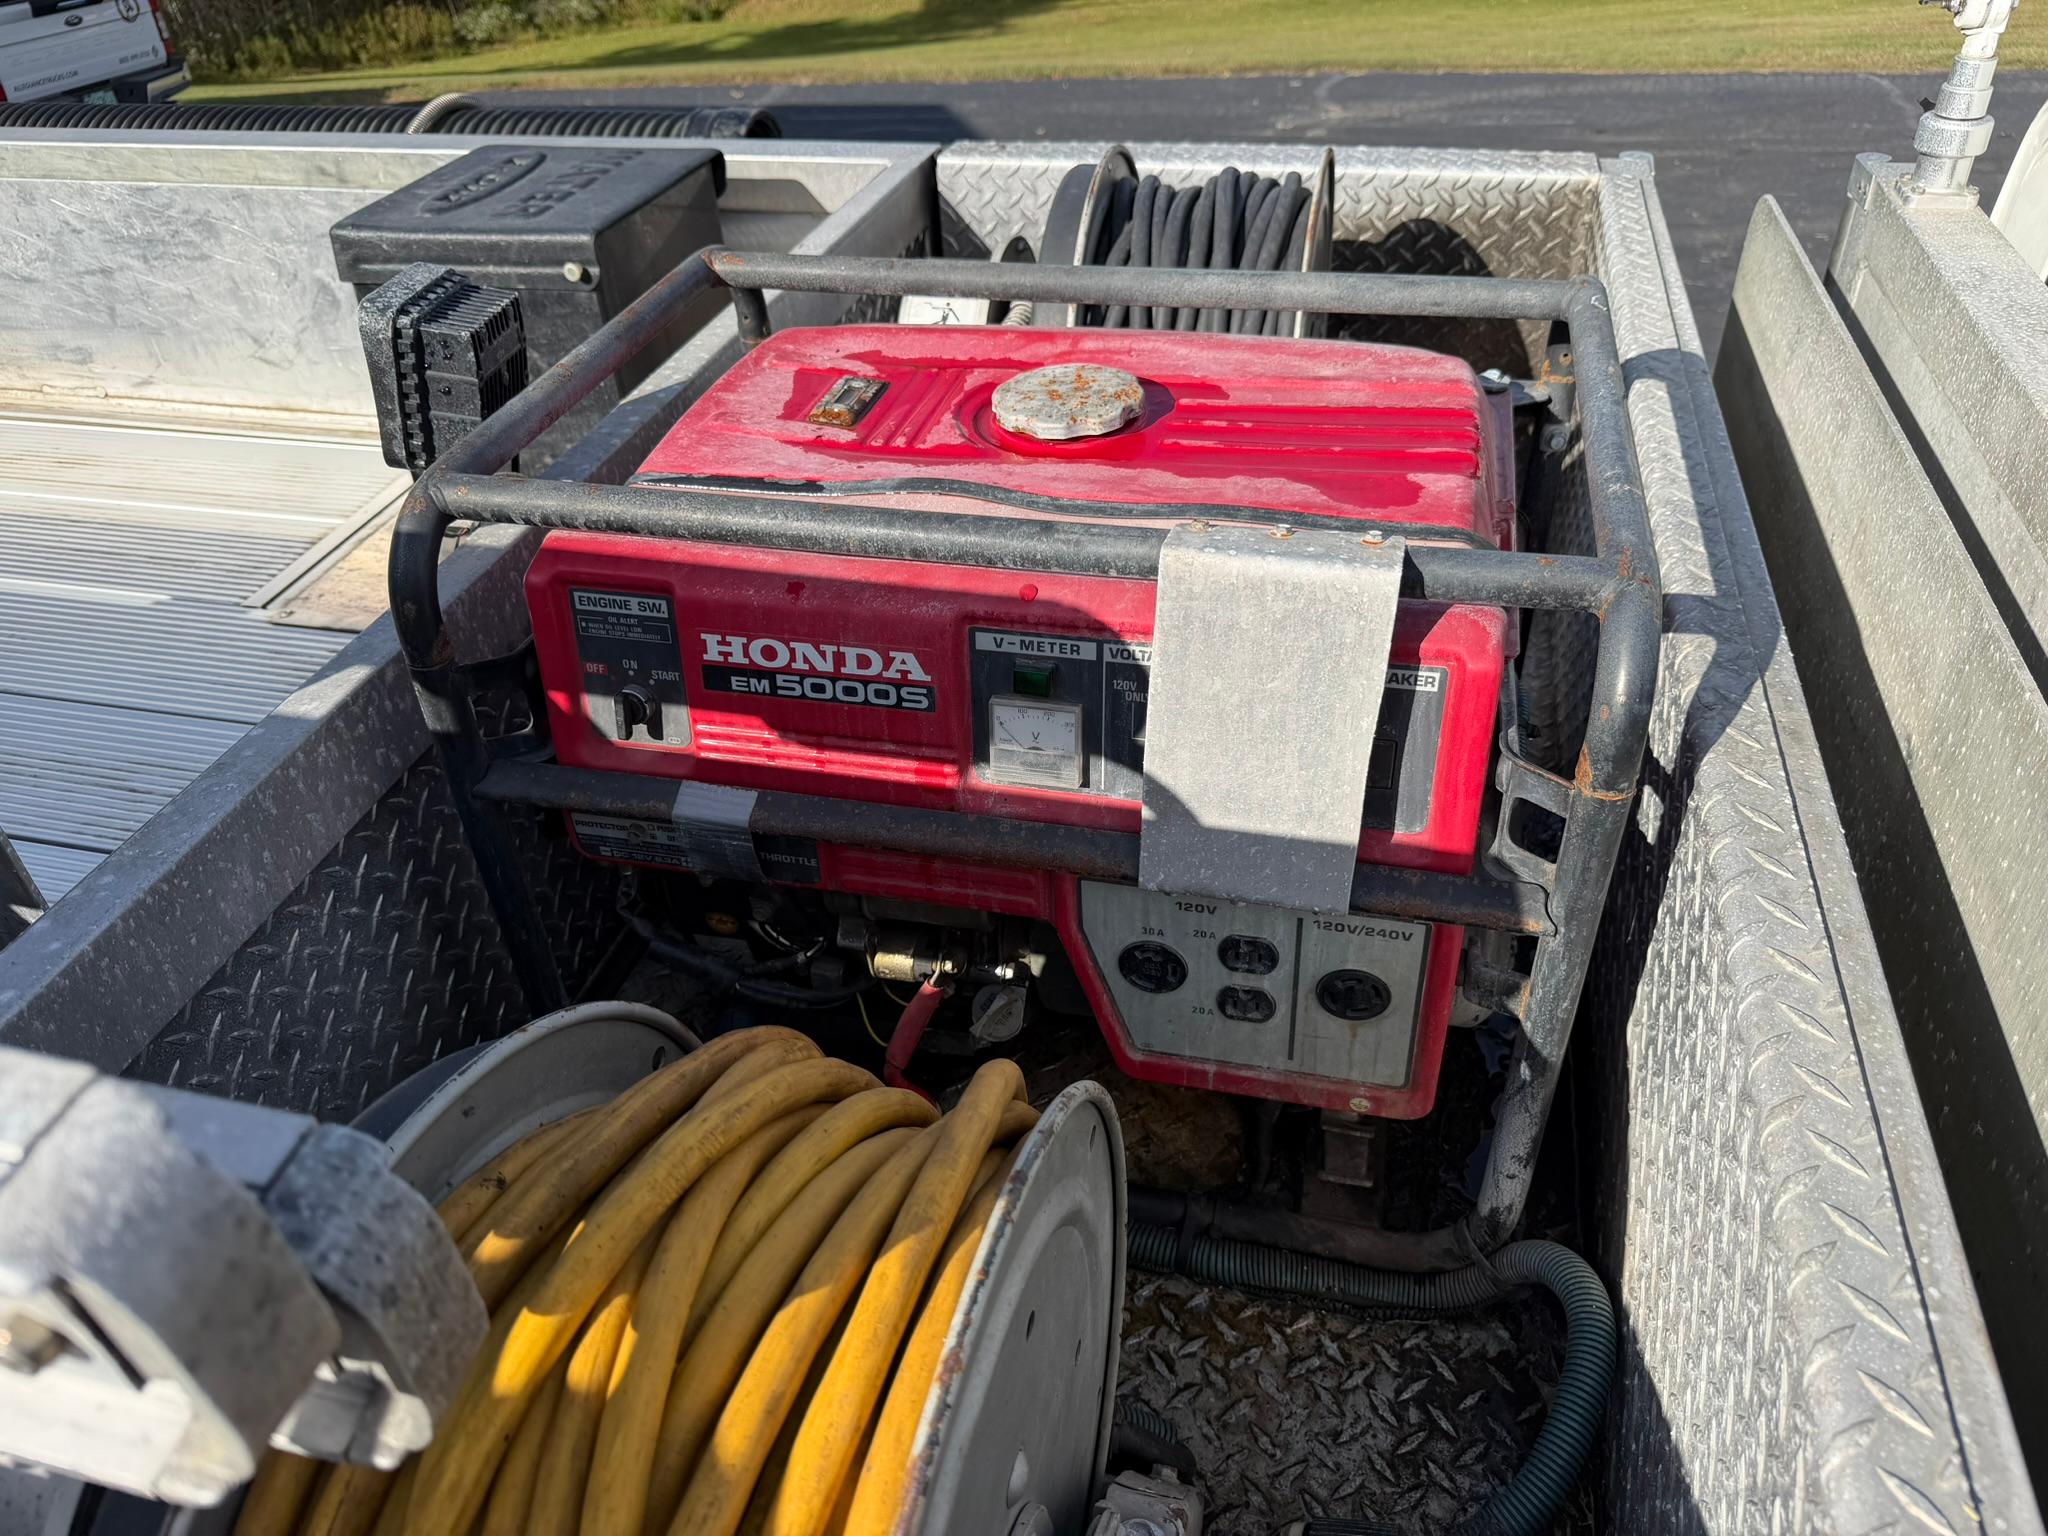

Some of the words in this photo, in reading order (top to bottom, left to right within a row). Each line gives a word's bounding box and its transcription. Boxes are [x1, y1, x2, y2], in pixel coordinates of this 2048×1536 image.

[578, 595, 632, 611] ENGINE
[638, 601, 665, 614] SW.
[607, 616, 618, 624] OIL
[701, 633, 931, 681] HONDA
[586, 662, 605, 673] OFF
[622, 659, 638, 669] ON
[651, 670, 681, 681] START
[1386, 671, 1436, 688] AKER
[1112, 680, 1137, 691] 120V
[1125, 691, 1148, 703] ONL
[1031, 731, 1040, 740] V
[759, 852, 817, 867] THROTTLE
[1175, 901, 1217, 915] 120V
[1313, 920, 1414, 941] 120V/240V
